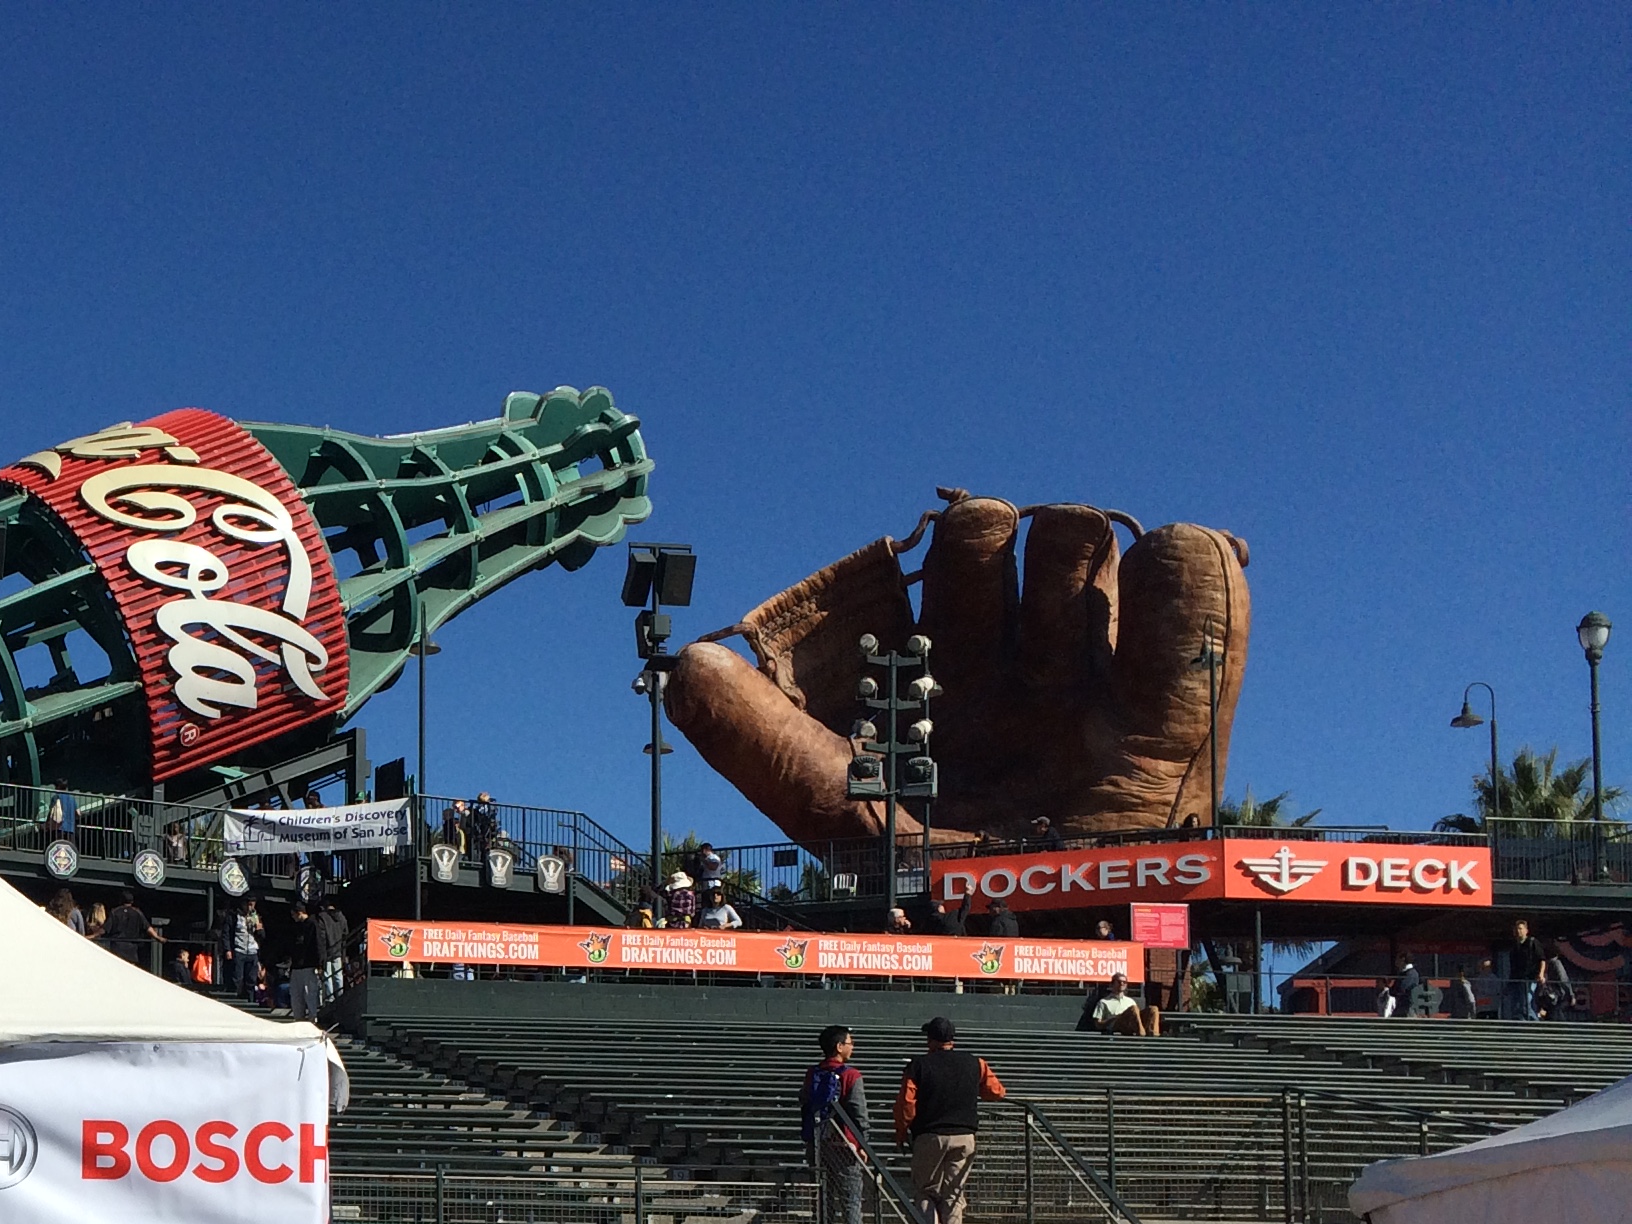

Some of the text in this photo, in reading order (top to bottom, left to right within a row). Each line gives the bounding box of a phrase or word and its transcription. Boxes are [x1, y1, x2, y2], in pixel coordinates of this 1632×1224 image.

[278, 808, 407, 827] Children's Discovery
[279, 831, 330, 843] Museum
[334, 827, 348, 840] of
[351, 826, 375, 839] San
[943, 853, 1481, 901] DOCKERS DECK
[423, 928, 539, 943] FREE Daily Fantasy Baseball
[621, 934, 736, 949] FREE Daily Fantasy Baseball
[423, 941, 539, 960] DRAFTKINGS.COM
[621, 946, 737, 966] DRAFTKINGS.COM
[818, 939, 933, 954] FREE Daily Fantasy Baseball
[1014, 945, 1127, 960] FREE Daily Fantasy Baseball
[818, 952, 933, 971] DRAFTKINGS.COM
[1014, 957, 1128, 976] DRAFTKINGS.COM
